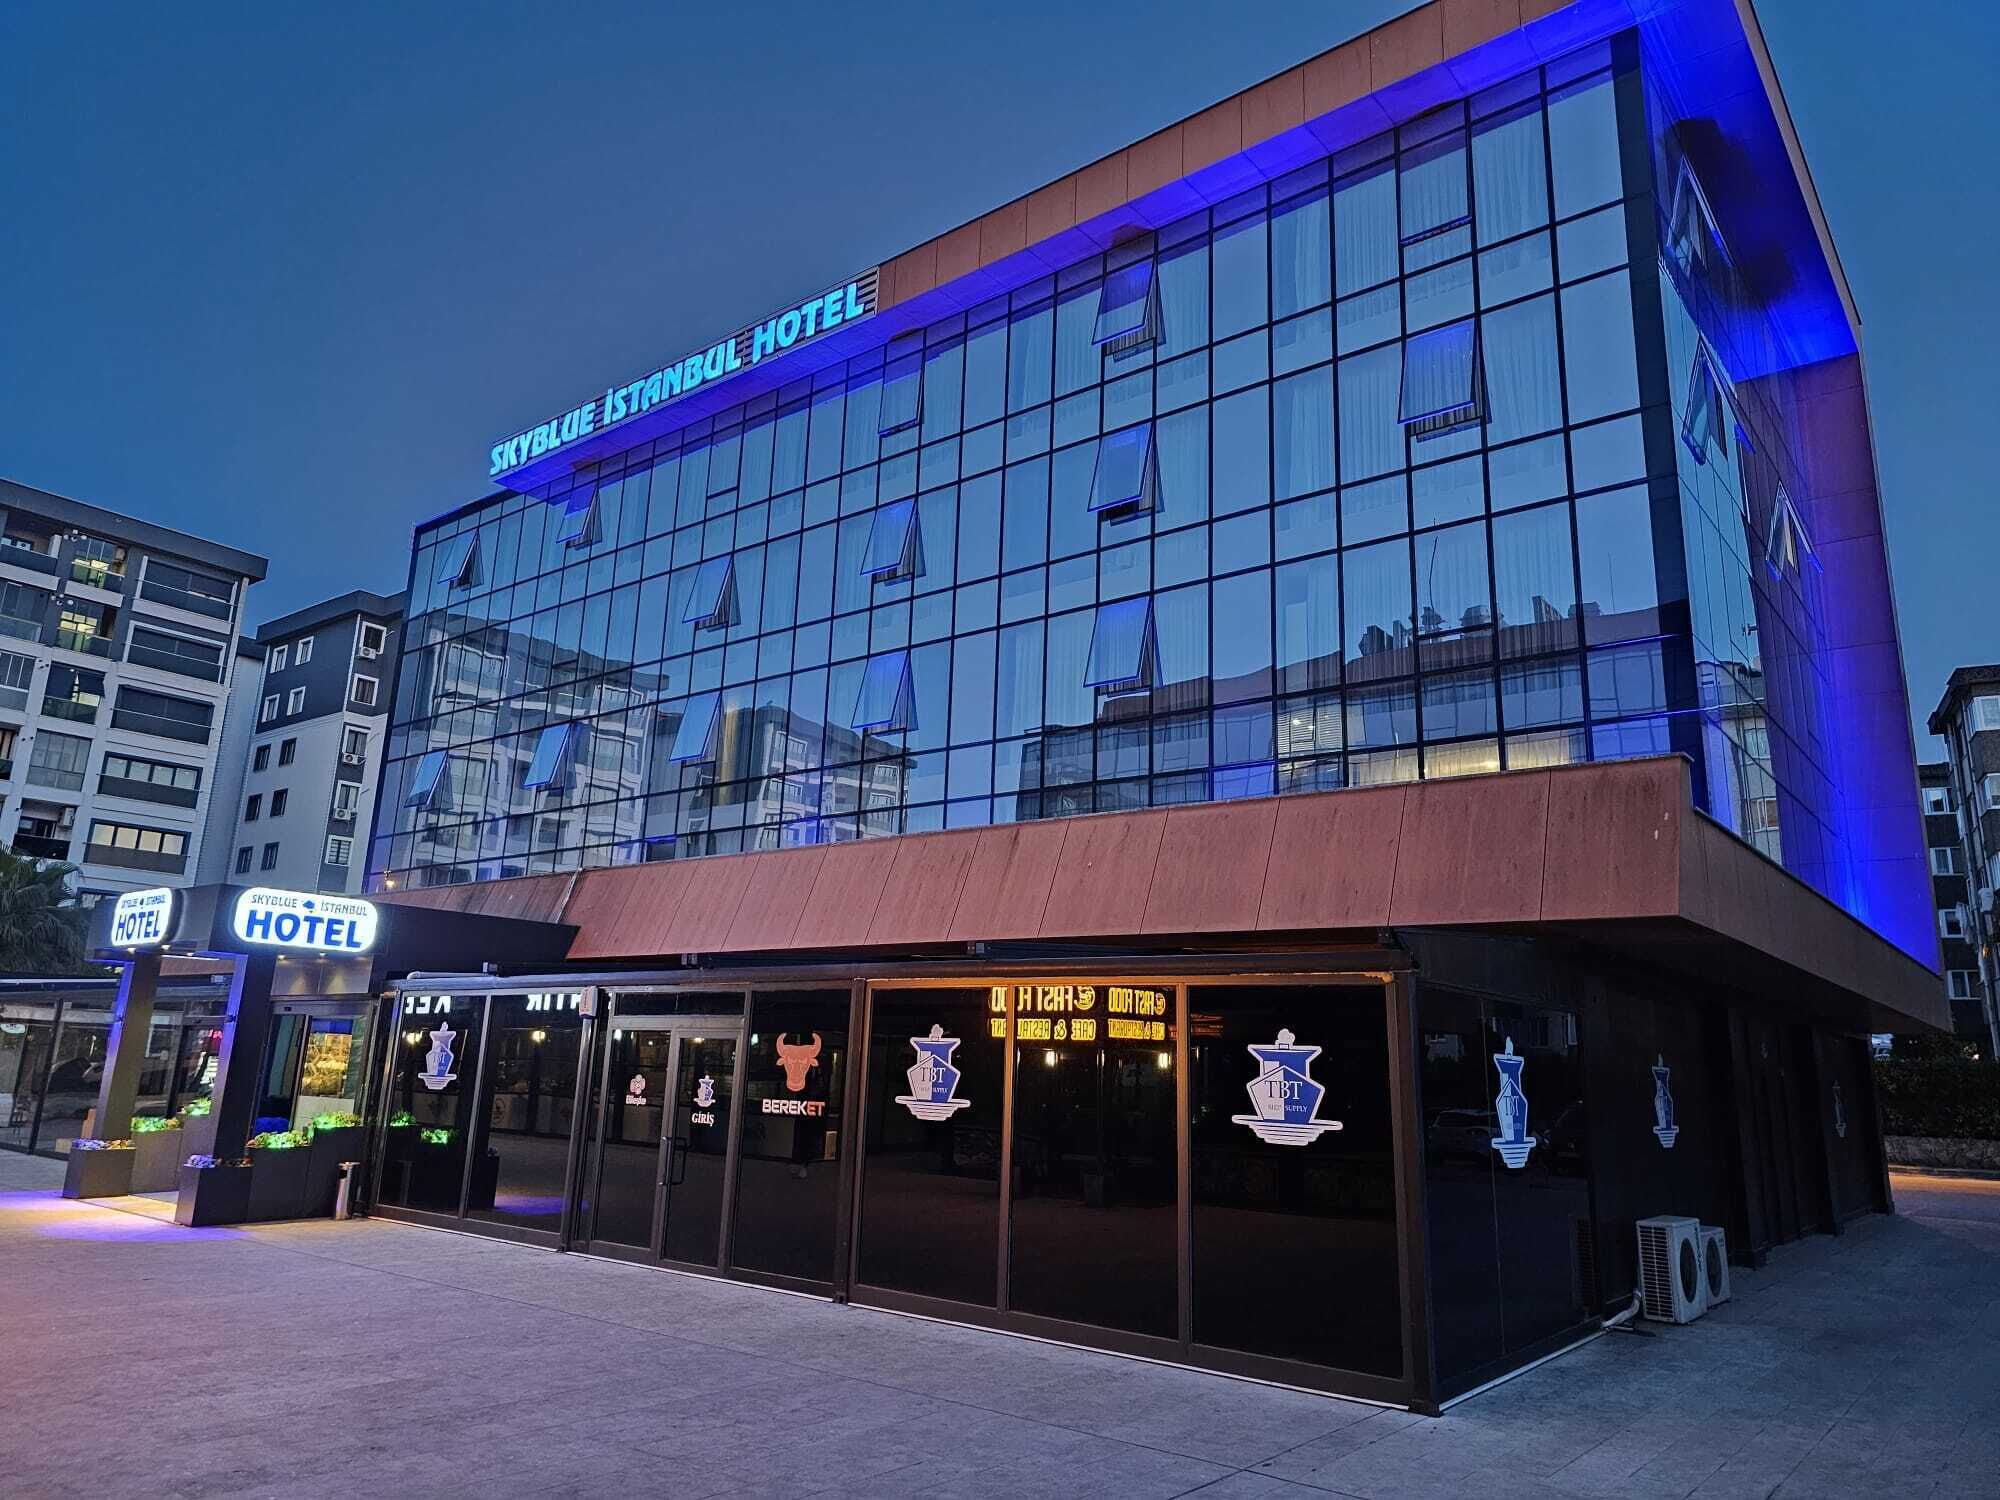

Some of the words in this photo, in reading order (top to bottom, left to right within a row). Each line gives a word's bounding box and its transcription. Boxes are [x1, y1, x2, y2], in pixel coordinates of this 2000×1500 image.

[489, 400, 598, 476] SKYBLUE
[751, 282, 866, 364] HOTEL
[251, 894, 299, 909] SKYBLUE
[115, 909, 161, 941] HOTEL
[246, 909, 363, 949] HOTEL
[919, 1066, 947, 1084] TBT
[1264, 1080, 1303, 1100] TBT
[761, 1098, 826, 1117] BEREKET
[691, 1110, 715, 1127] GİRİŞ
